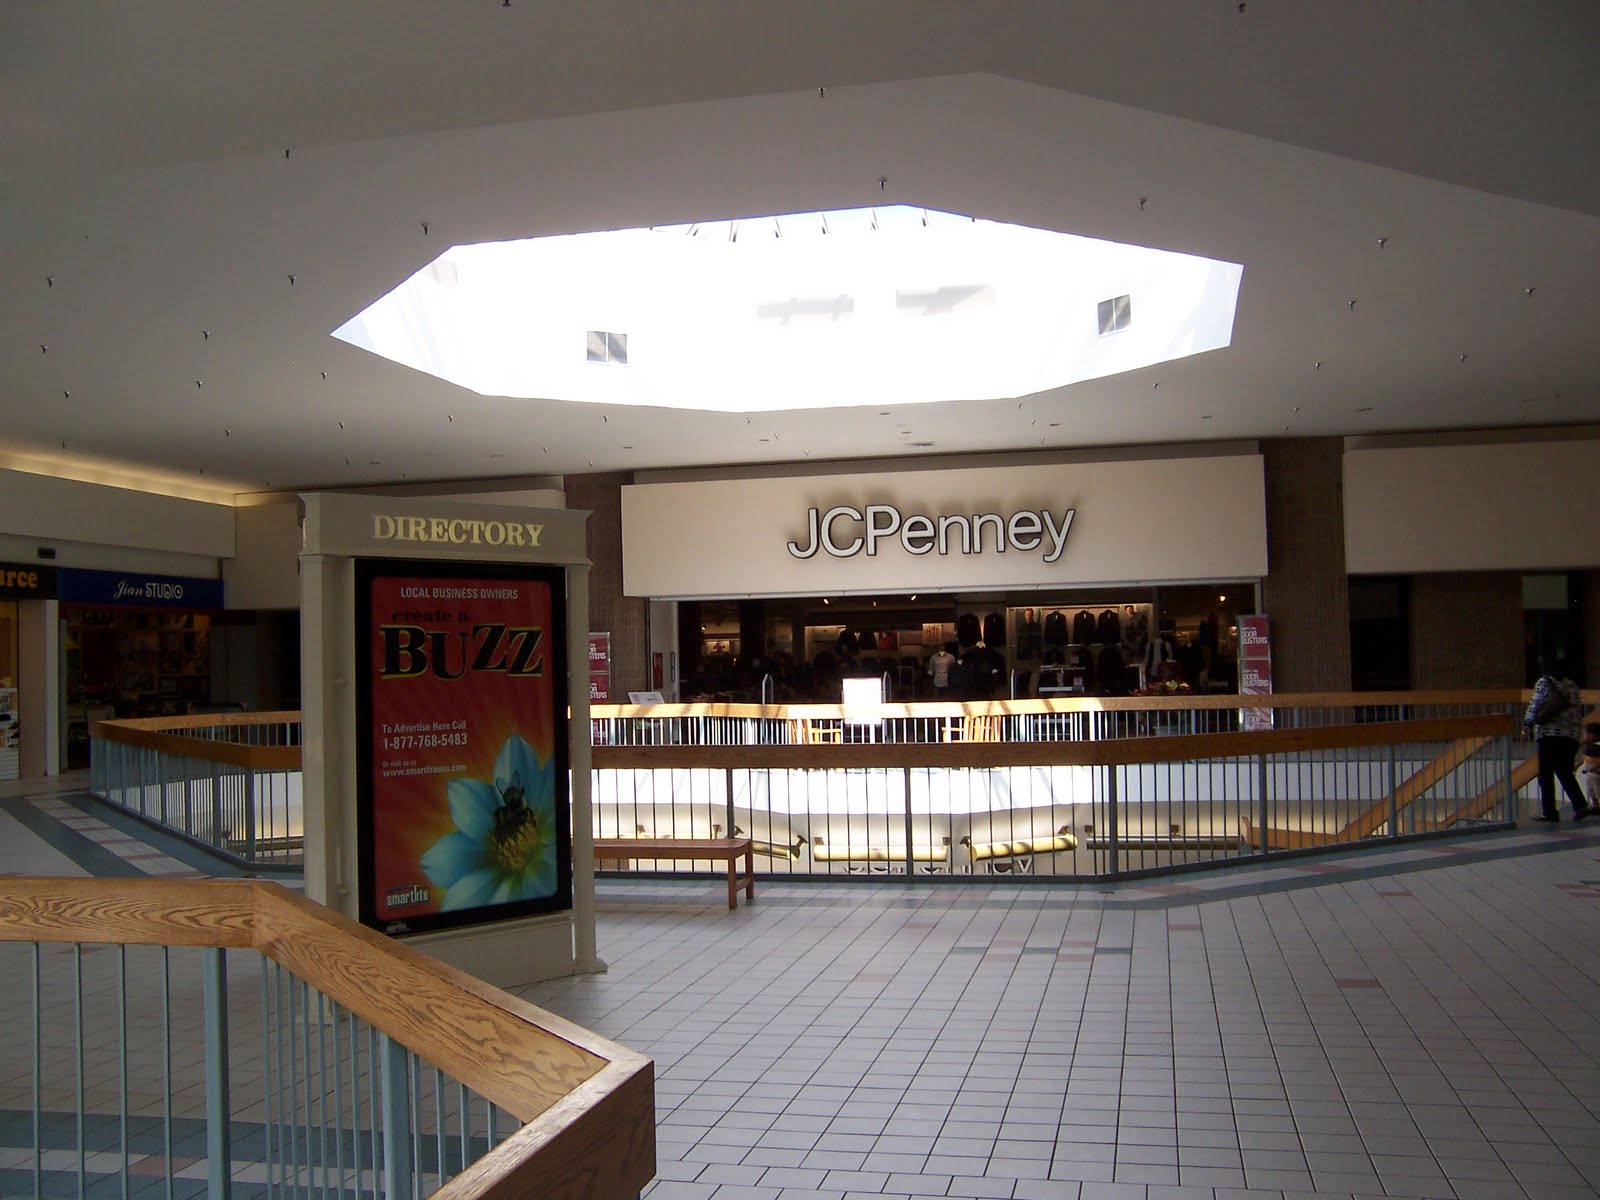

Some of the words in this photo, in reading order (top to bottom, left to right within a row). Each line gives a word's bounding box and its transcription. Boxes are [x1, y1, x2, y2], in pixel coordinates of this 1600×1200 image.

[371, 514, 544, 547] DIRECTORY
[787, 504, 1076, 563] JCPenney
[112, 579, 144, 600] Jian
[145, 582, 184, 599] STUDIO
[400, 587, 430, 598] LOCAL
[432, 588, 478, 599] BUSINESS
[480, 589, 519, 600] OWNERS
[392, 609, 452, 622] create
[458, 612, 468, 622] a
[379, 623, 543, 681] BUZZ
[382, 724, 392, 733] To
[394, 722, 430, 733] Advertise
[432, 721, 450, 731] Here
[452, 720, 467, 730] Call
[383, 733, 468, 750] 1-877-768-5483
[386, 885, 429, 906] smartlite
